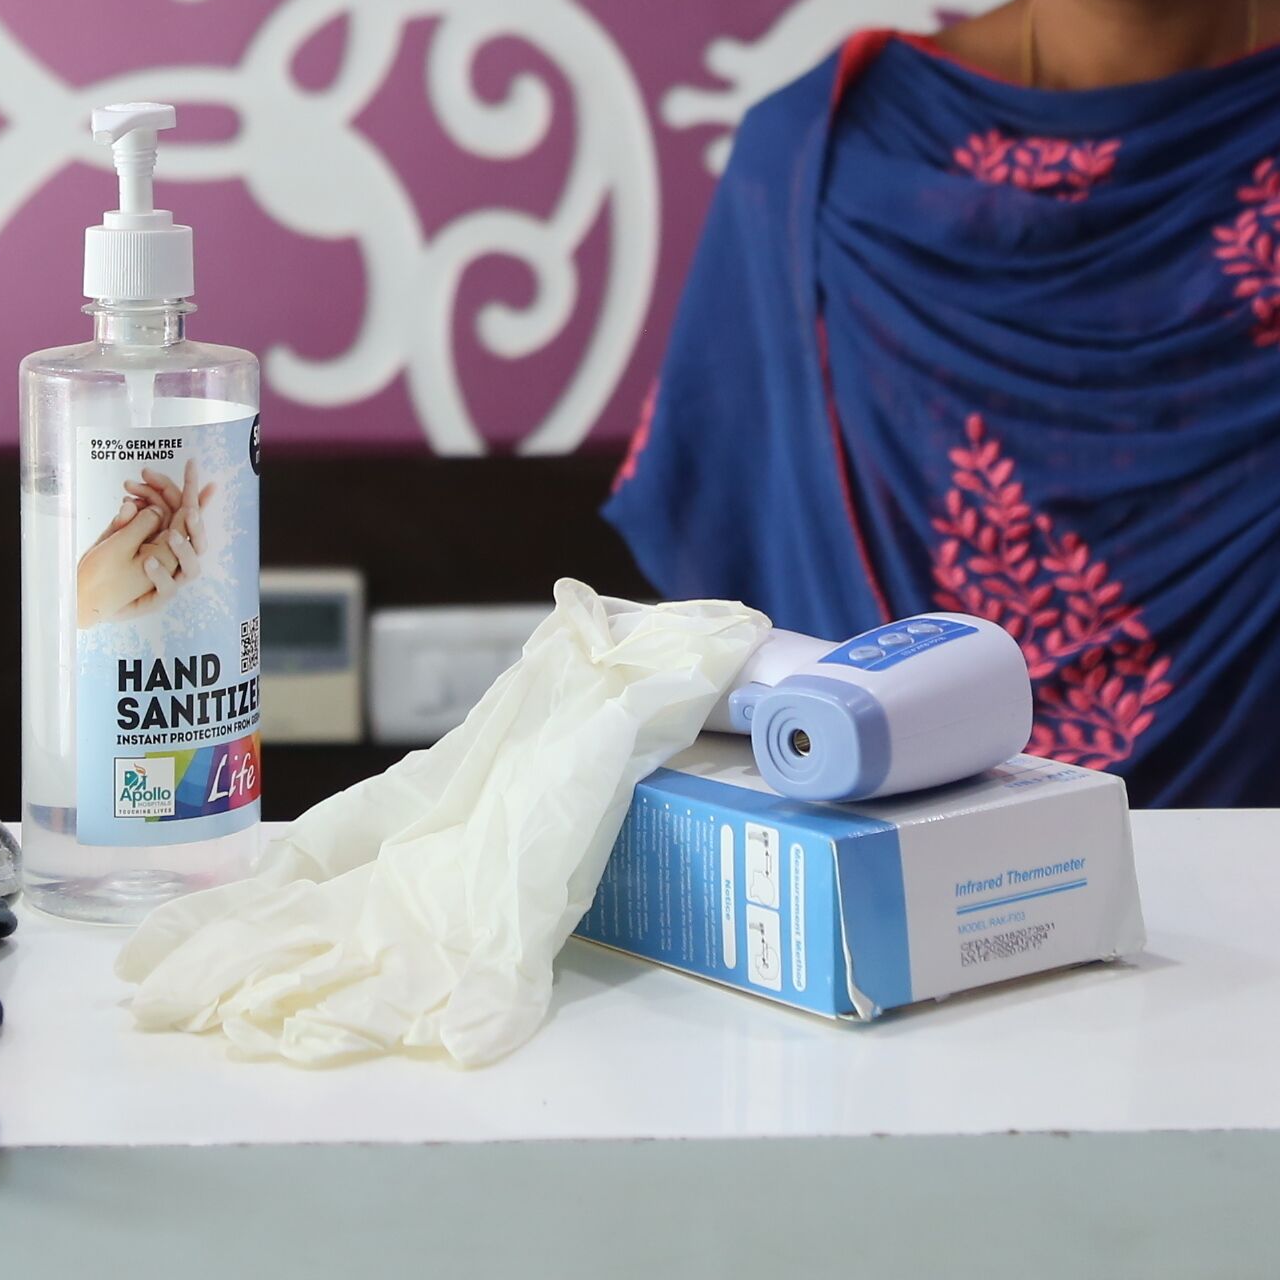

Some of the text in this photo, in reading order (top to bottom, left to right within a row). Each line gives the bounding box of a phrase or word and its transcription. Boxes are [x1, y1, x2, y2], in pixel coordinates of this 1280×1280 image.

[91, 438, 182, 450] 99.9% GERM FREE
[91, 450, 174, 461] SOFT ON HANDS
[118, 653, 221, 692] HAND
[117, 675, 259, 730] SANITIZE
[117, 733, 167, 745] INSTANT
[170, 724, 232, 743] PROTECTION
[233, 719, 251, 733] FROM
[208, 752, 256, 802] Life
[120, 787, 171, 808] Apollo
[955, 858, 1086, 897] Infrared Thermometer
[724, 878, 732, 922] Notice
[795, 939, 803, 988] Method
